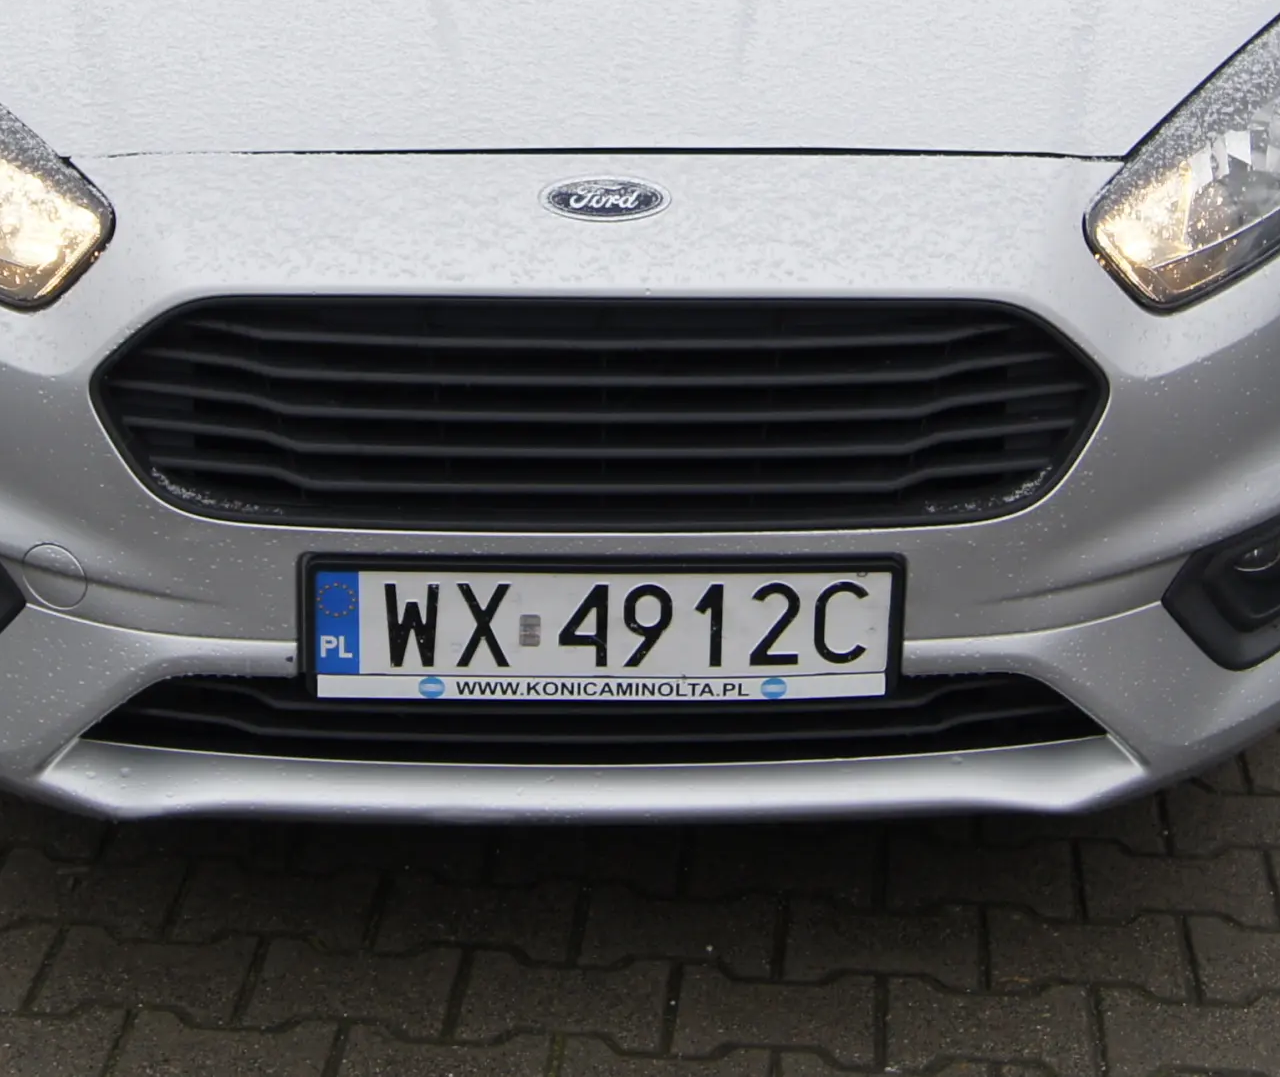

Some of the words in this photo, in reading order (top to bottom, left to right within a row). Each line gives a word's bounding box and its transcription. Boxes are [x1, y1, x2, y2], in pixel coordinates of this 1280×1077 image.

[569, 183, 641, 209] Ford
[319, 635, 354, 660] PL
[384, 582, 512, 668] WX
[558, 580, 870, 666] 4912C
[456, 680, 750, 698] WWW.KONICAMINOLTA.PL
